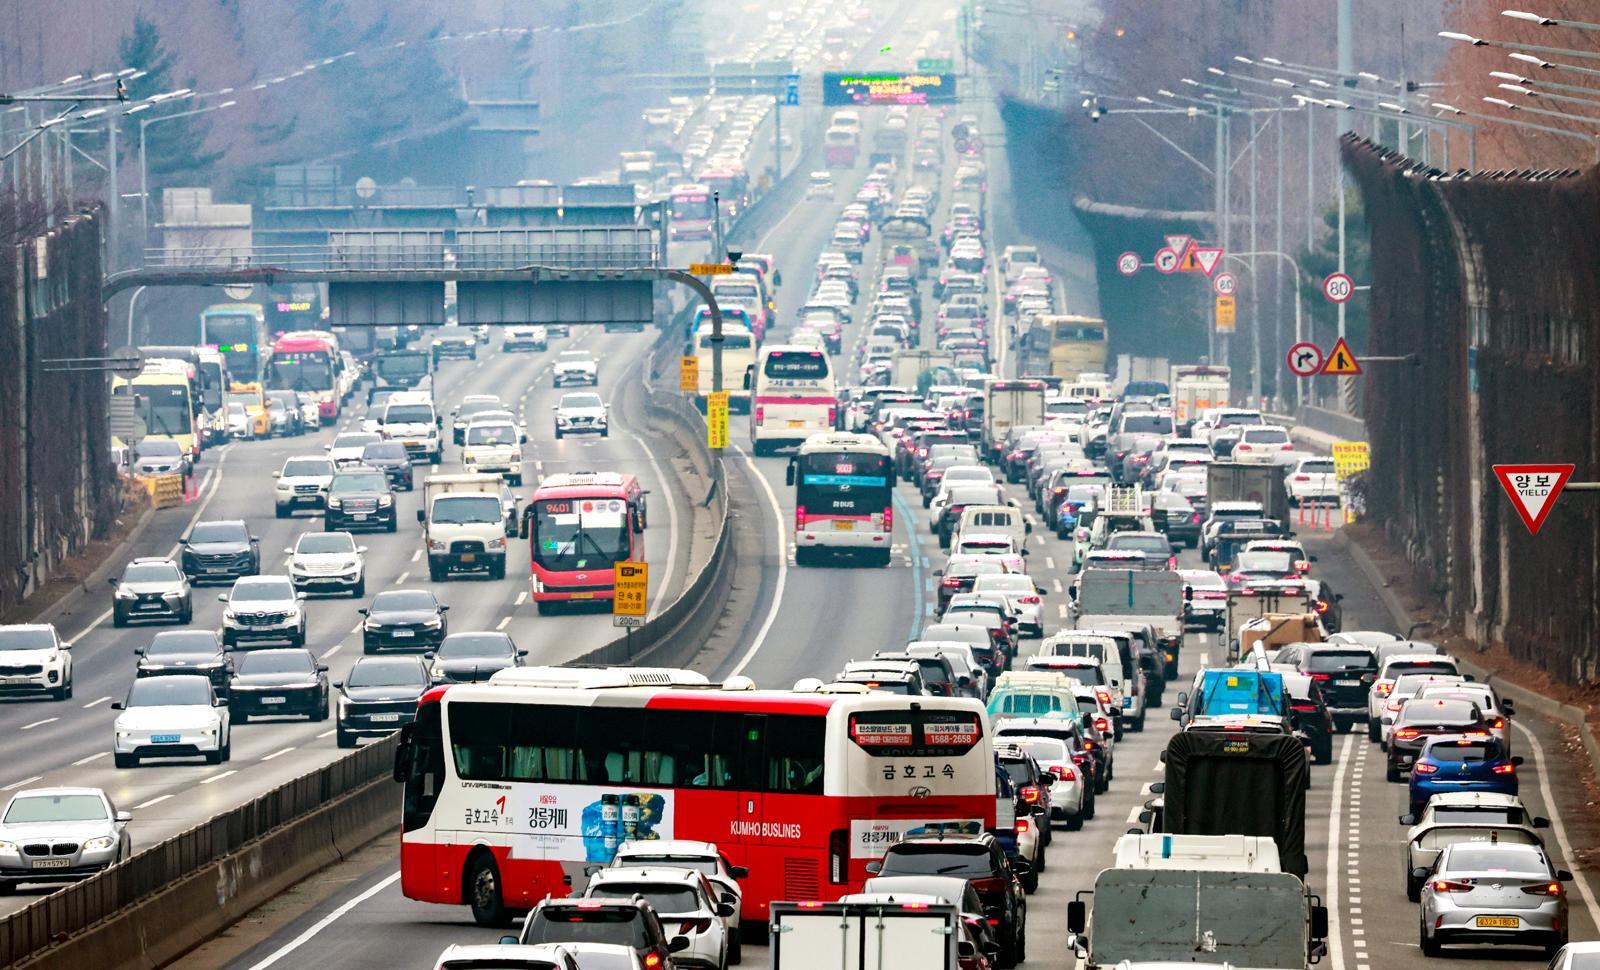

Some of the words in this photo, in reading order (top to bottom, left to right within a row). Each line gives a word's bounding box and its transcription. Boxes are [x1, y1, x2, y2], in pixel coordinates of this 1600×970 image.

[1330, 281, 1349, 296] 80
[836, 464, 853, 474] 9003
[1515, 474, 1551, 488] 양보
[1518, 489, 1548, 497] YIELD
[546, 503, 569, 513] 9401
[619, 616, 640, 626] 200m
[882, 763, 954, 779] 금호고속
[464, 808, 498, 826] 금호고속
[528, 807, 567, 829] 강릉커피
[730, 820, 761, 836] KUMHO
[762, 822, 801, 839] BUSLINES
